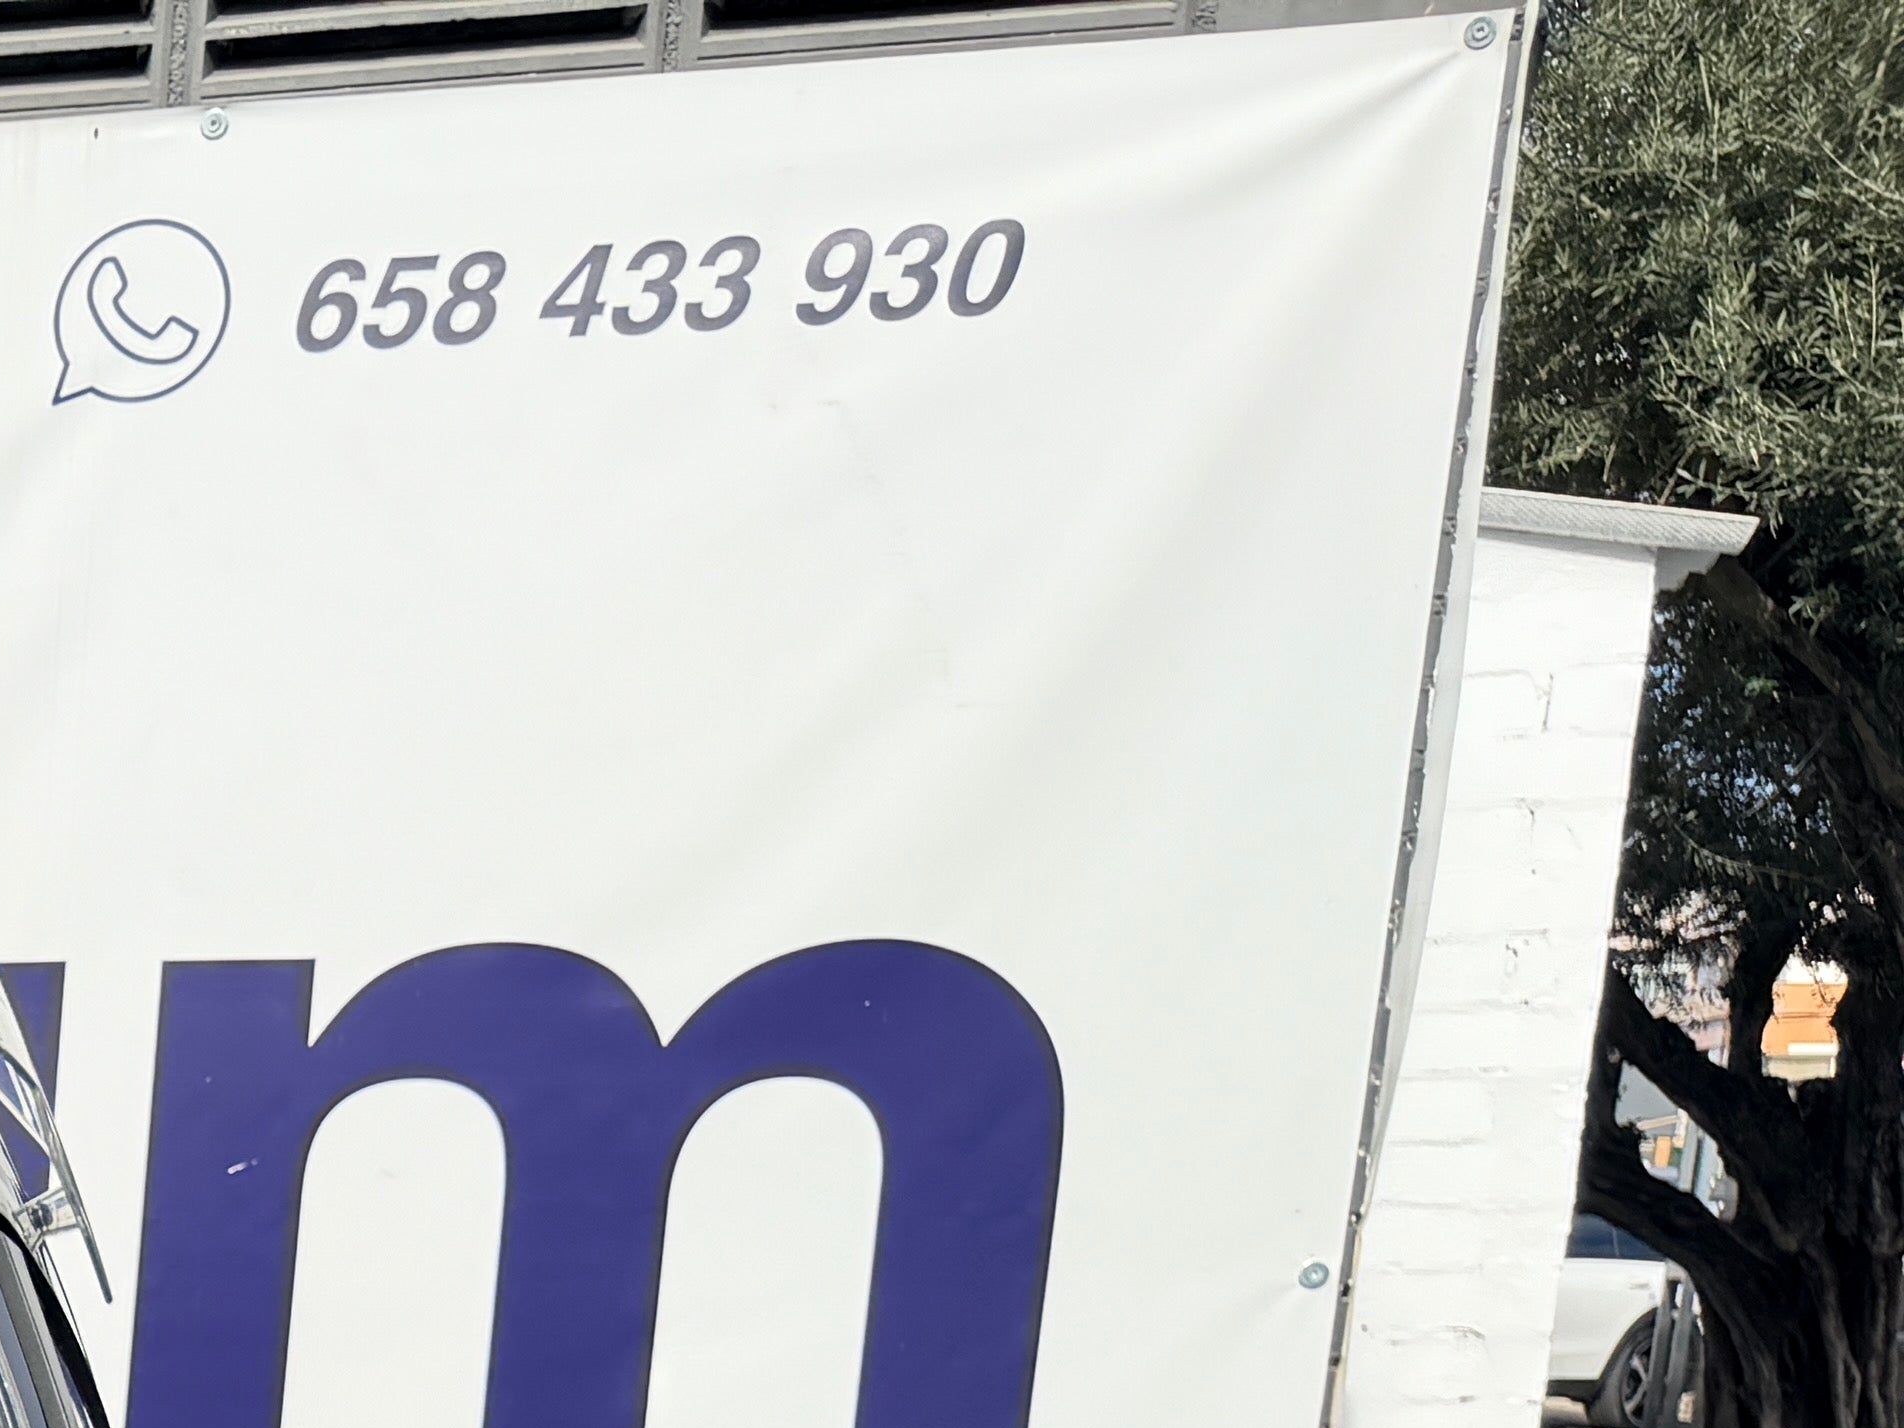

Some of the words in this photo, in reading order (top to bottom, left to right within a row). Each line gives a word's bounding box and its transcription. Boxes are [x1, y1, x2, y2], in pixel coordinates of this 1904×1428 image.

[297, 251, 506, 352] 658
[540, 236, 760, 336] 433
[796, 220, 1025, 325] 930
